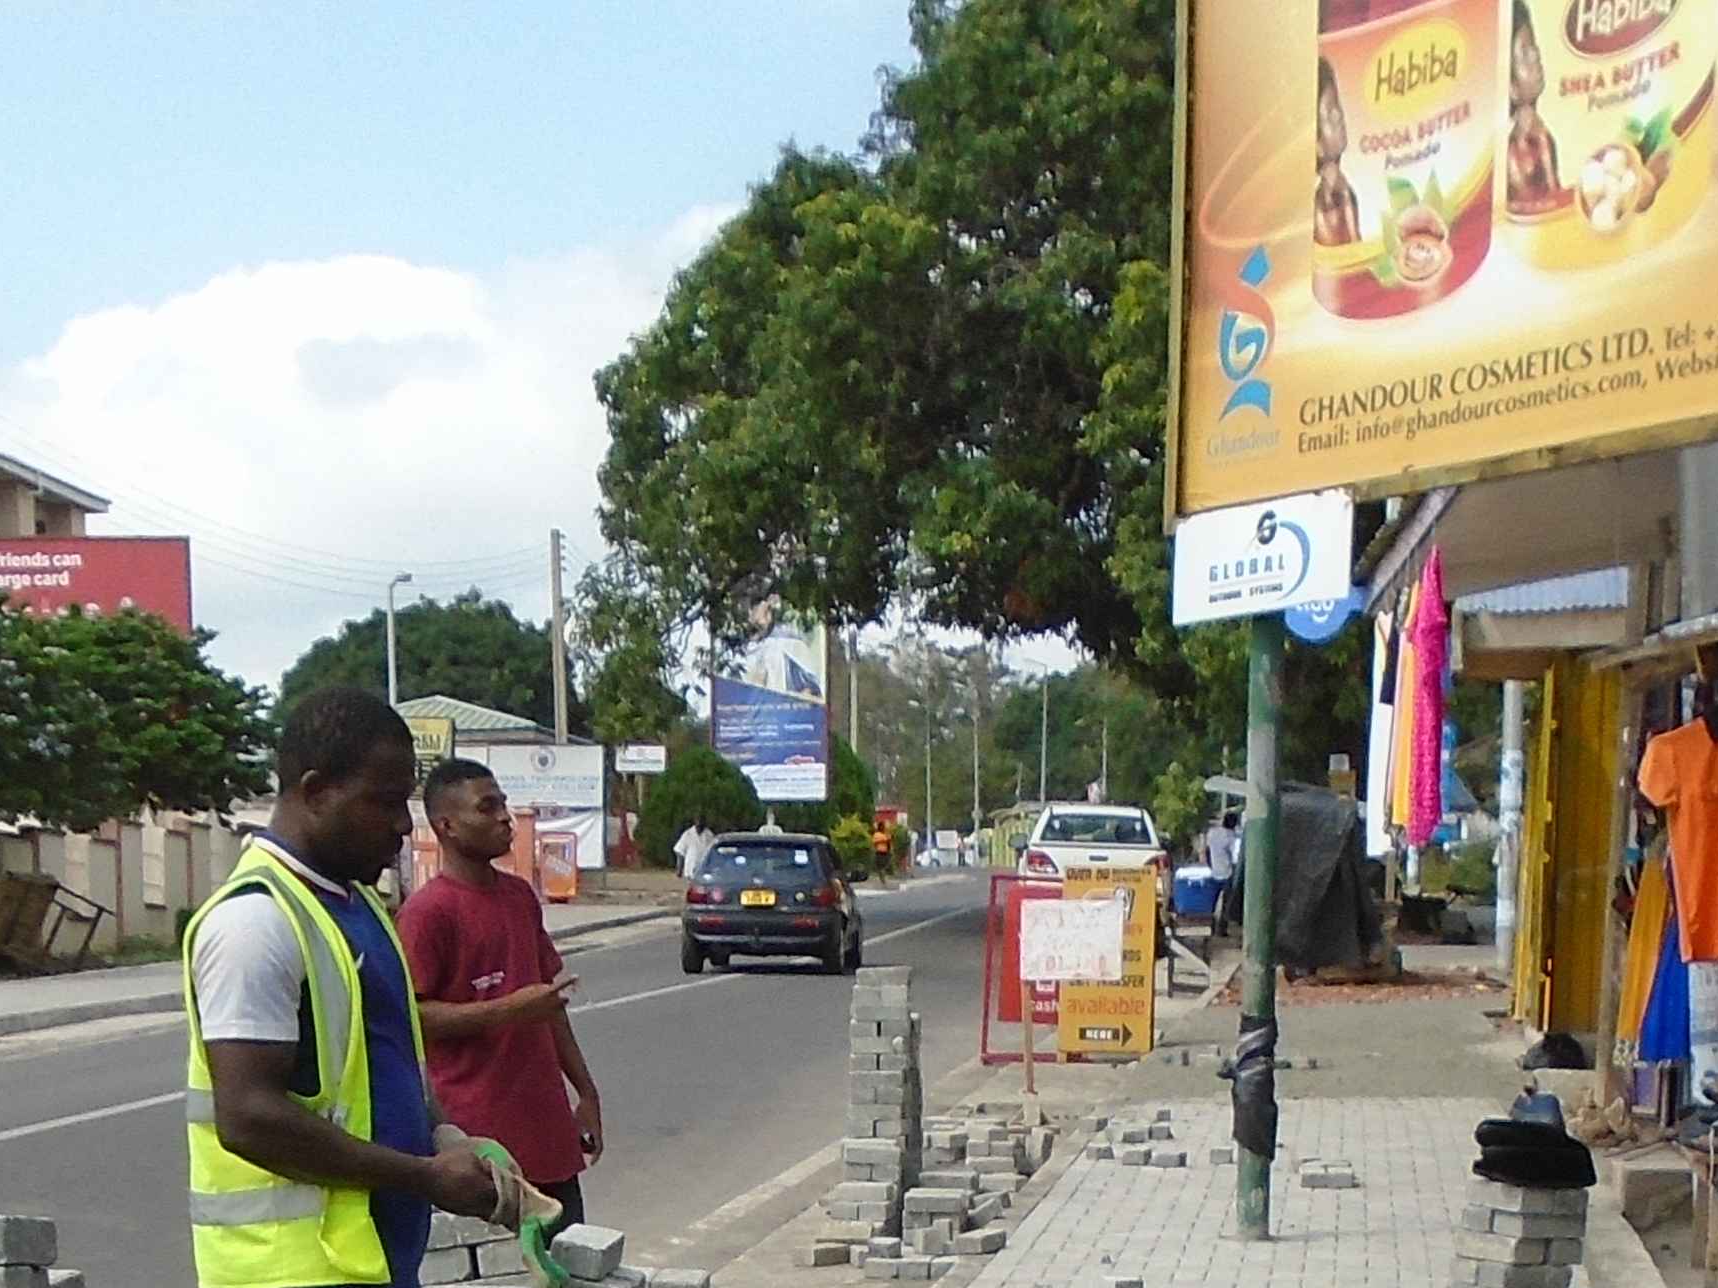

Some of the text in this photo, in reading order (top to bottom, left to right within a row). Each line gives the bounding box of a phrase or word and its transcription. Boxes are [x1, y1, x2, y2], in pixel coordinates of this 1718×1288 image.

[1374, 42, 1459, 103] Habiba
[1612, 41, 1680, 85] BUTTER
[1359, 100, 1472, 154] COCOA BUTTER
[1298, 373, 1443, 426] GHANDOUR
[1449, 338, 1594, 395] COSMETICS
[1600, 327, 1654, 365] LTD.
[1662, 320, 1696, 352] Tel:
[1297, 423, 1351, 454] Email:
[1355, 366, 1648, 443] info@ghandourcosmetics.com,
[33, 571, 70, 586] card
[52, 554, 82, 567] can
[1208, 554, 1286, 583] GLOBAL
[1066, 995, 1146, 1015] available
